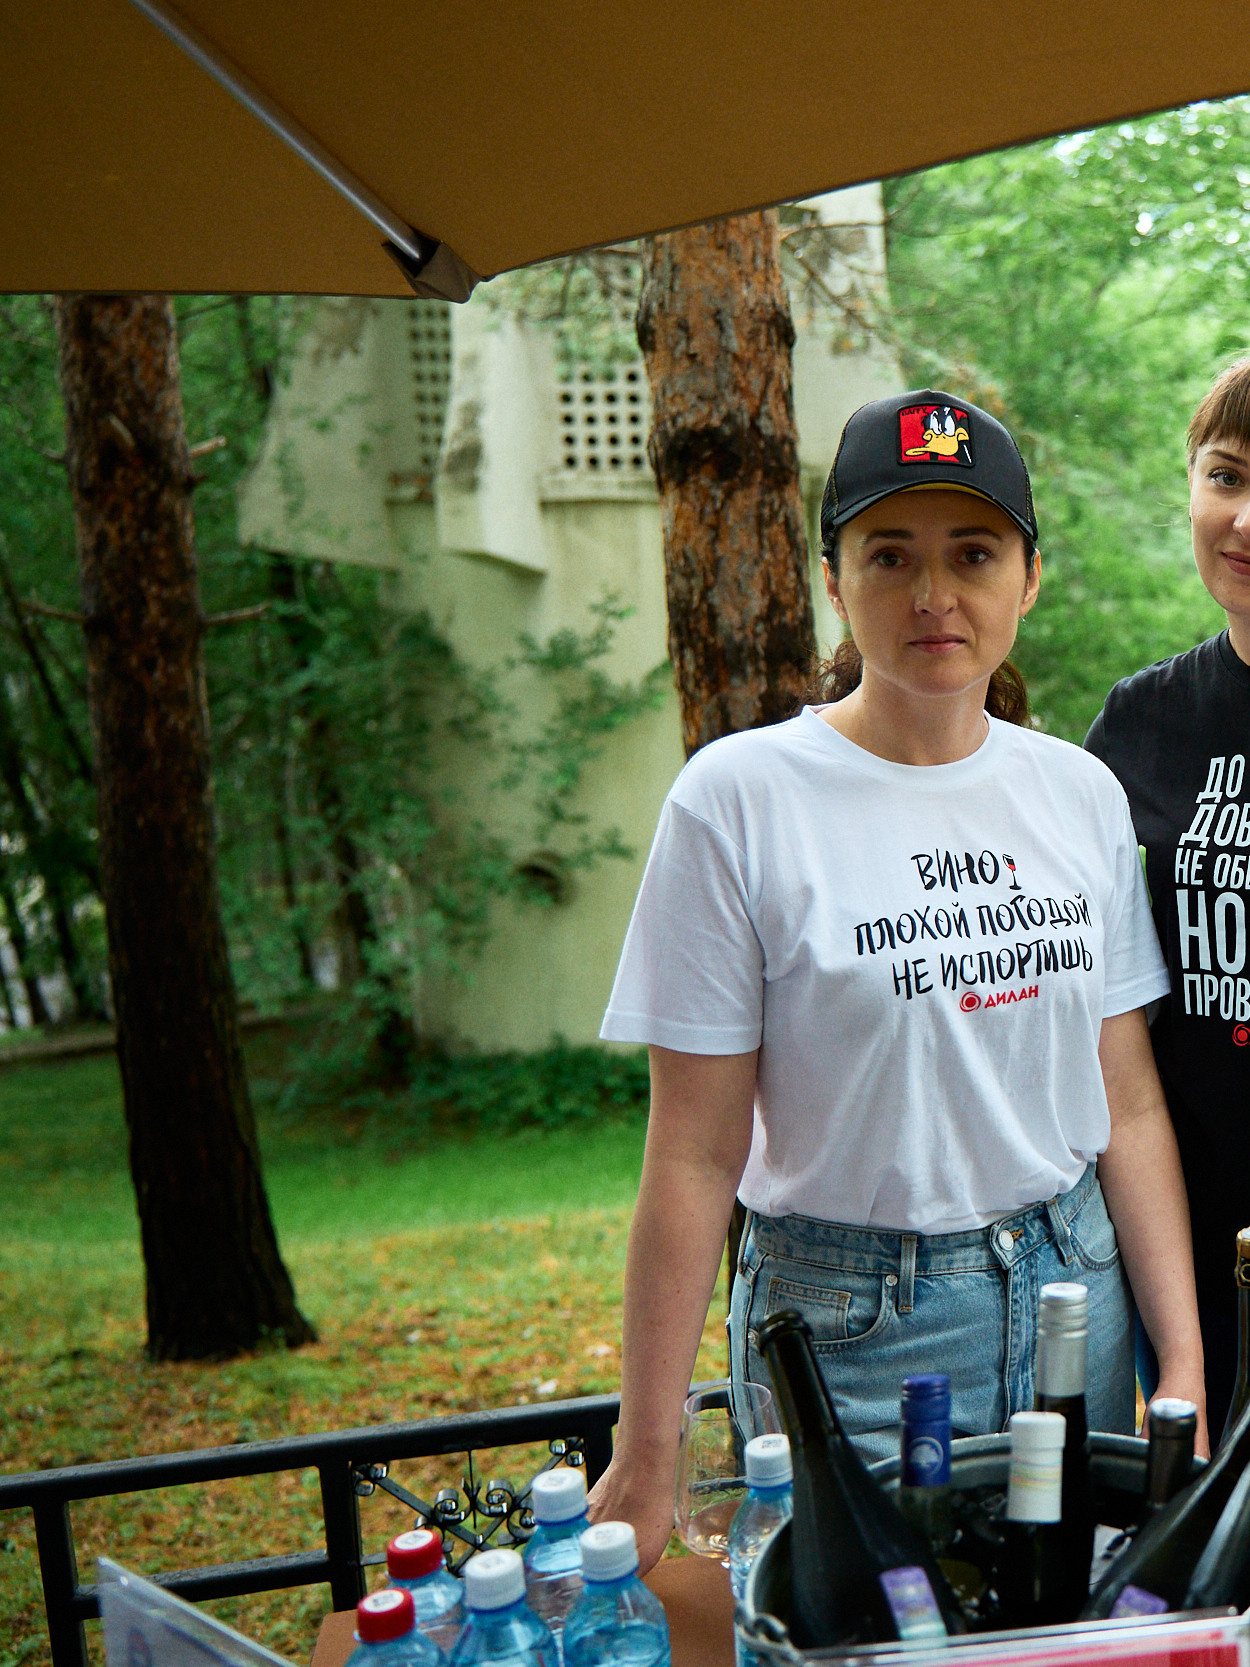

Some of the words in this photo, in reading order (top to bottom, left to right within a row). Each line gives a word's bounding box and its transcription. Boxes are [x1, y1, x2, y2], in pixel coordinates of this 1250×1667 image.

[1195, 754, 1245, 803] ДО
[910, 848, 1000, 892] ВИНО
[1174, 847, 1208, 886] НЕ
[854, 902, 971, 956] ПЛОХОЙ
[976, 893, 1093, 936] ПОГОДОЙ
[1175, 888, 1247, 975] НО
[892, 958, 934, 1001] НЕ
[940, 936, 1093, 991] ИСПОРТИШЬ
[984, 985, 1039, 1009] ДИЛАН
